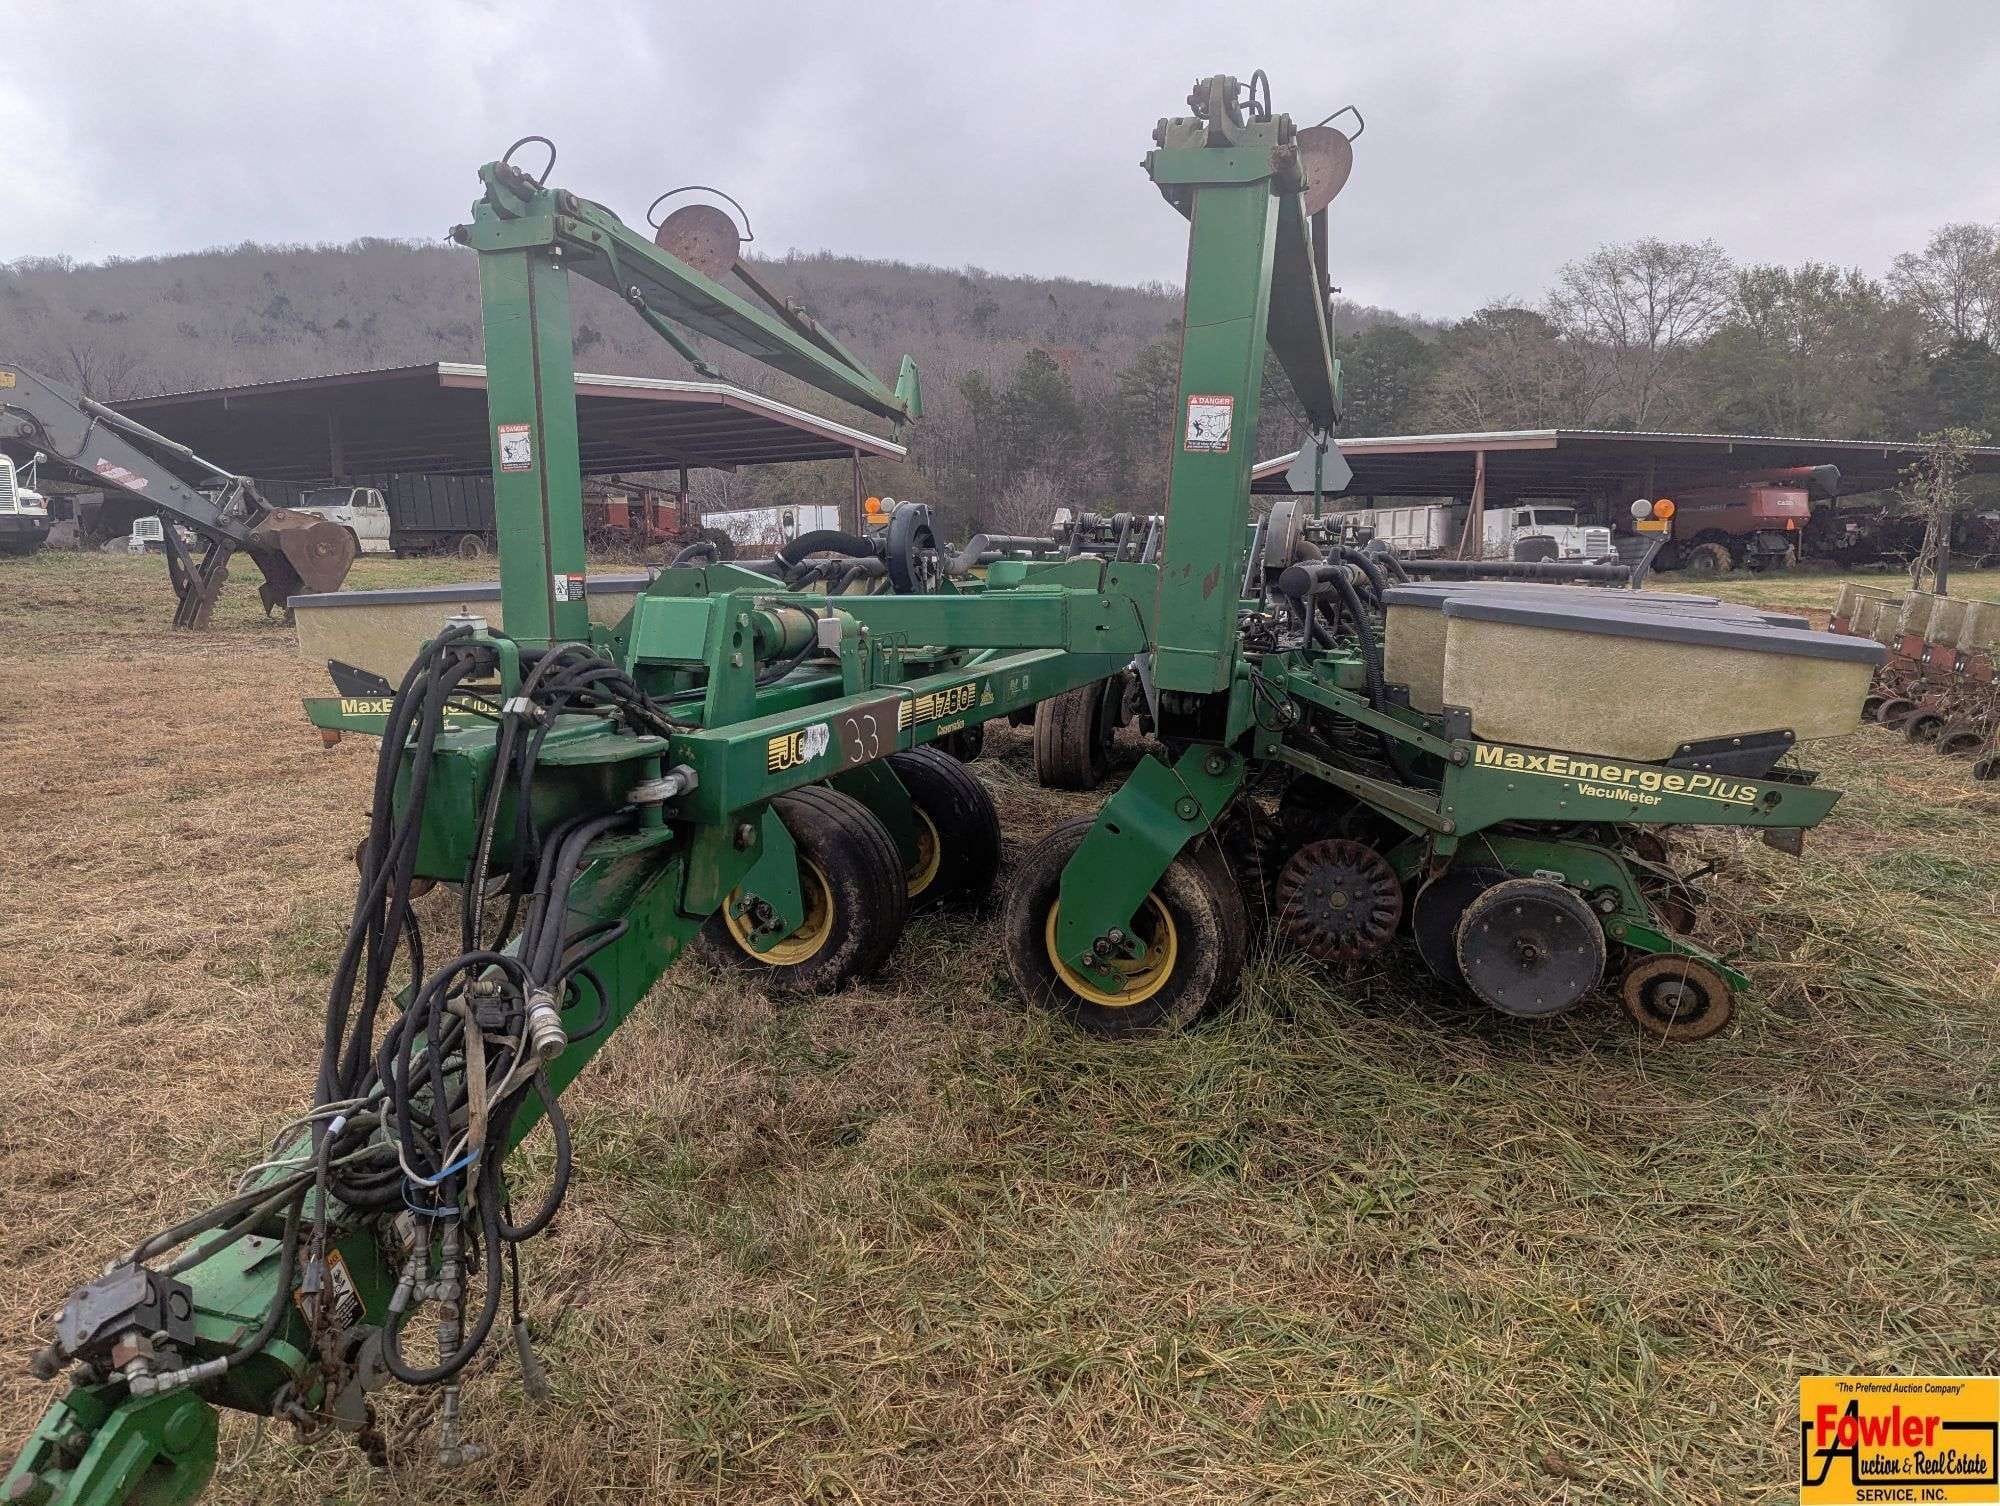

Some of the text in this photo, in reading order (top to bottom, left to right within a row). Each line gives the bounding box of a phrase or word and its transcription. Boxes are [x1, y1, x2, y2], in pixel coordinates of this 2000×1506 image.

[1199, 397, 1230, 405] DANGER
[931, 685, 969, 718] 1780
[845, 714, 879, 763] 33
[1474, 744, 1759, 801] MaxEmergePlus
[1578, 782, 1662, 806] VacuMeter
